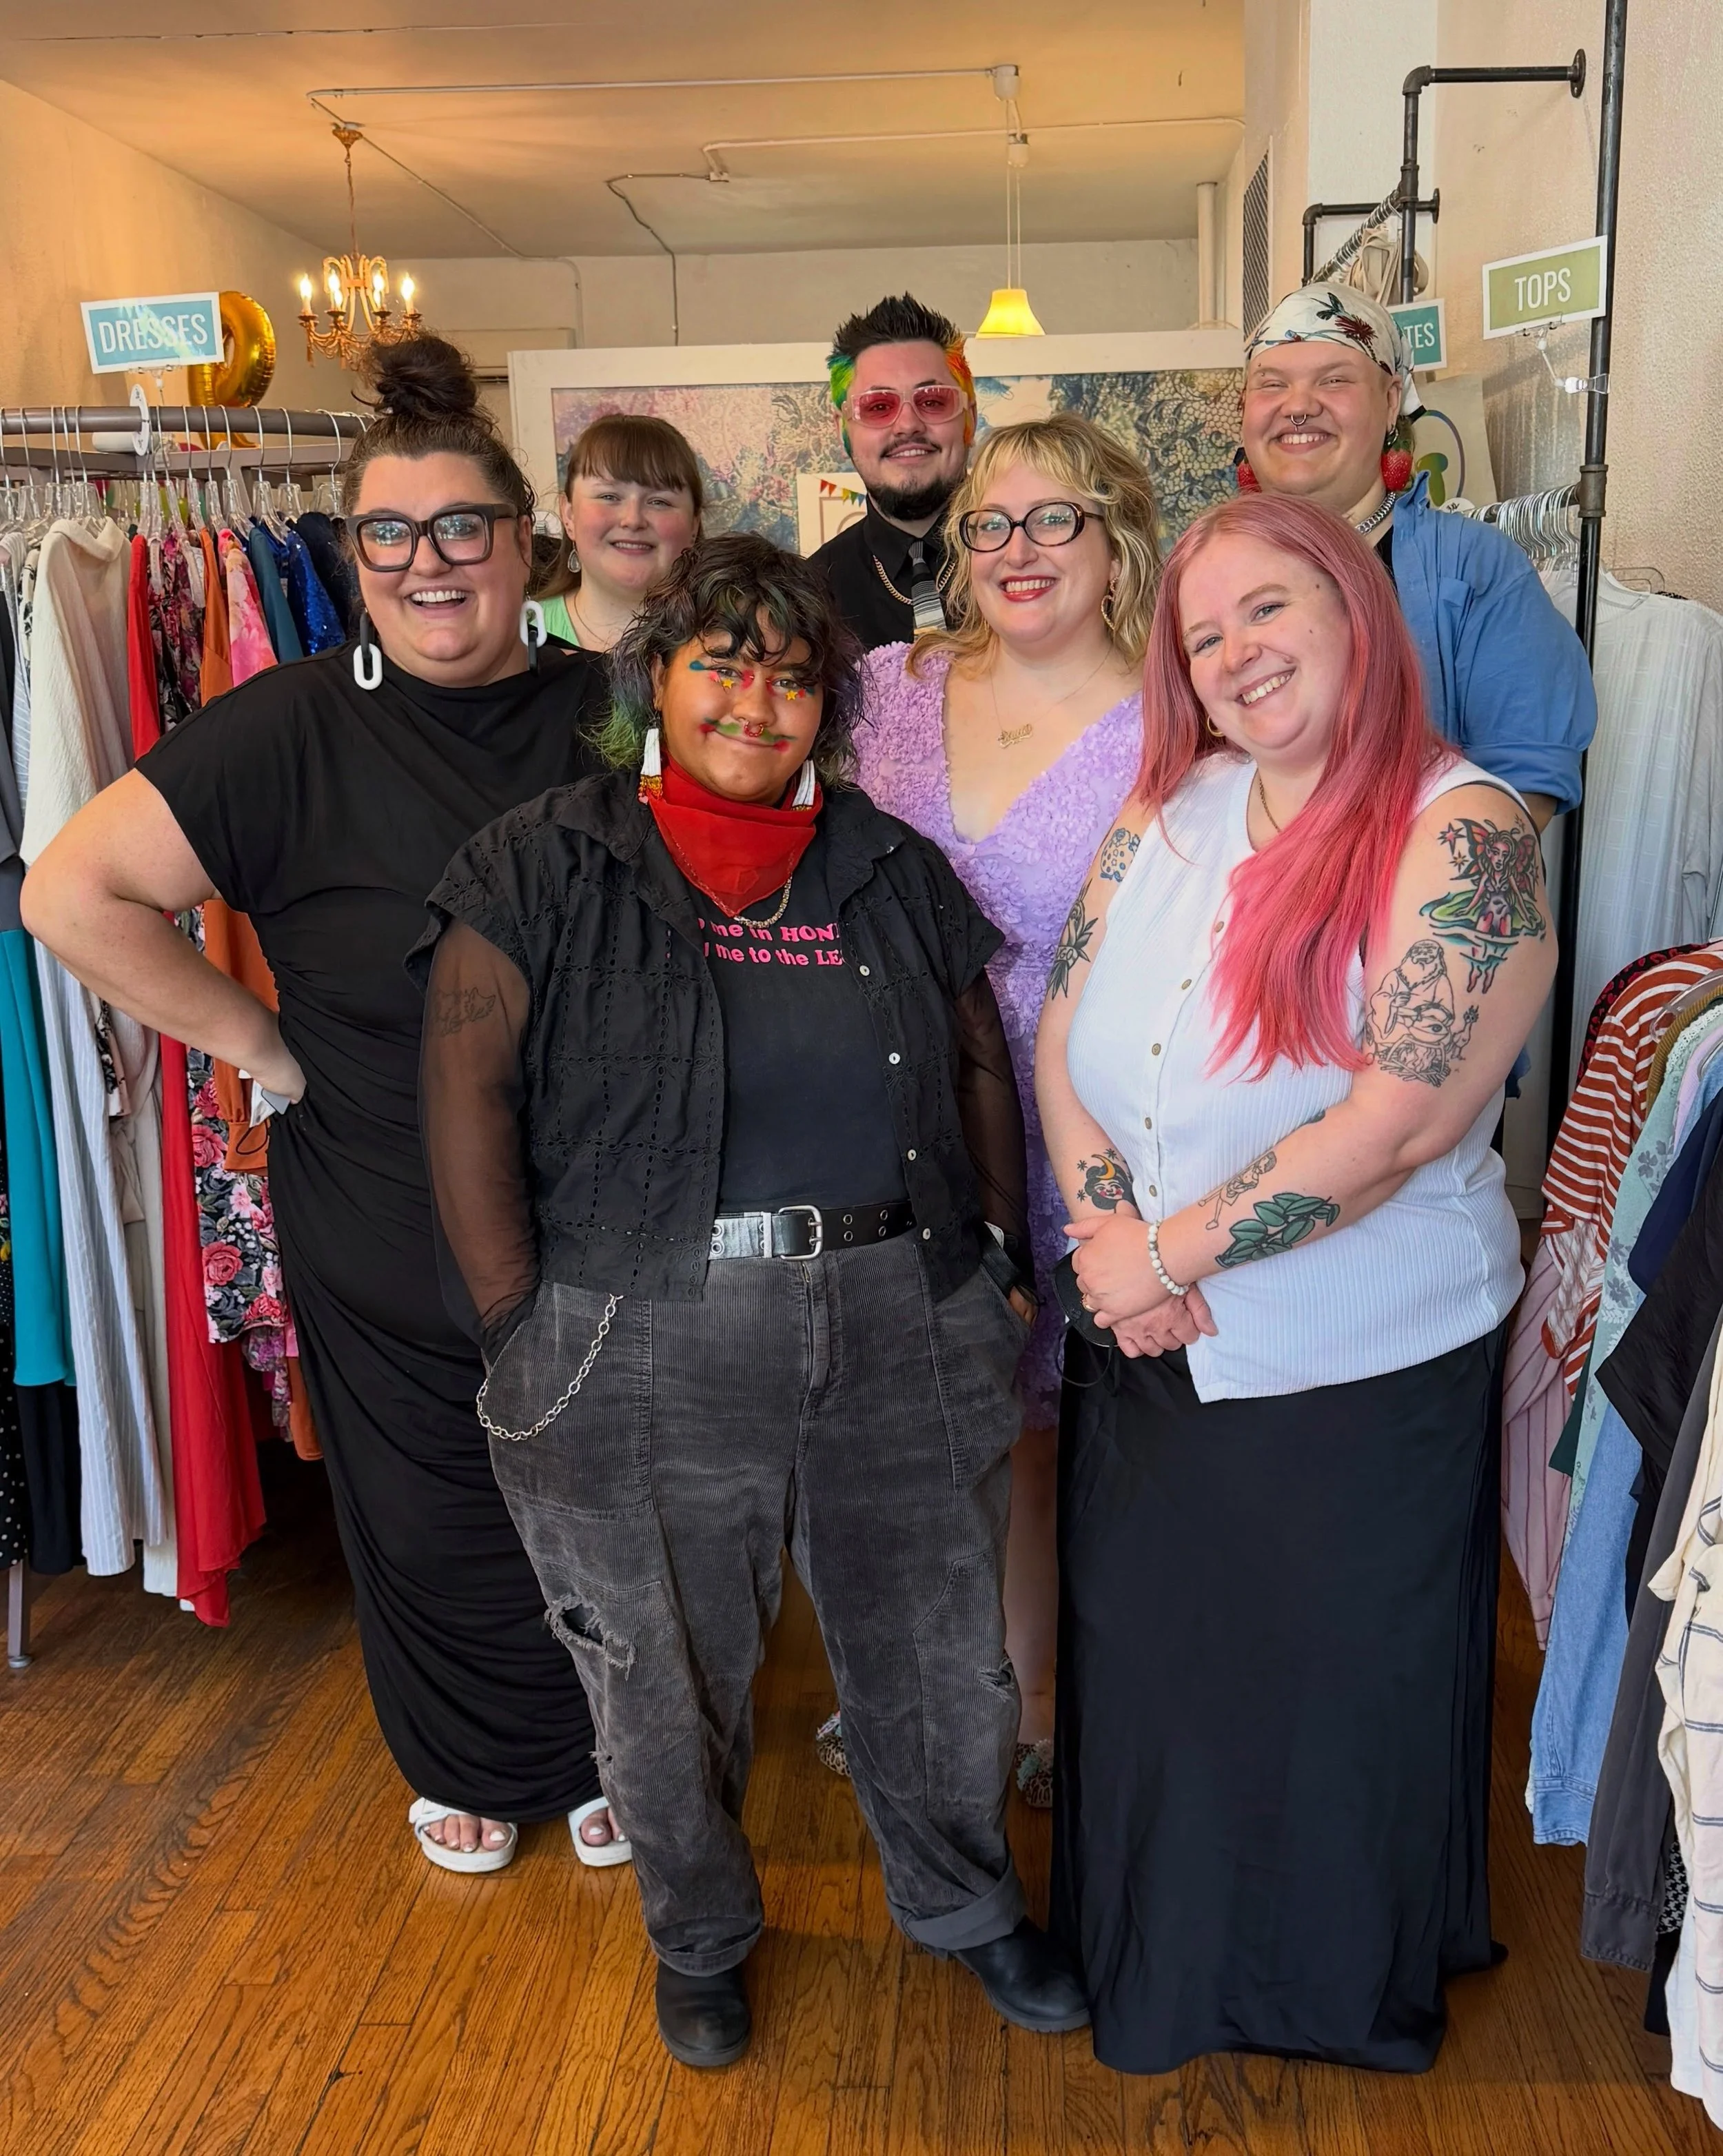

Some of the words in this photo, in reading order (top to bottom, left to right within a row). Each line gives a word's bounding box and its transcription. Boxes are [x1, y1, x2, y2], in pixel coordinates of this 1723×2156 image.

[1513, 267, 1571, 312] TOPS
[98, 313, 208, 354] DRESSES
[1403, 322, 1435, 348] TES
[710, 920, 744, 937] me
[748, 924, 773, 941] in
[779, 923, 839, 942] HON
[715, 943, 744, 962] me
[748, 946, 771, 963] to
[775, 948, 809, 965] the
[815, 949, 843, 965] LE
